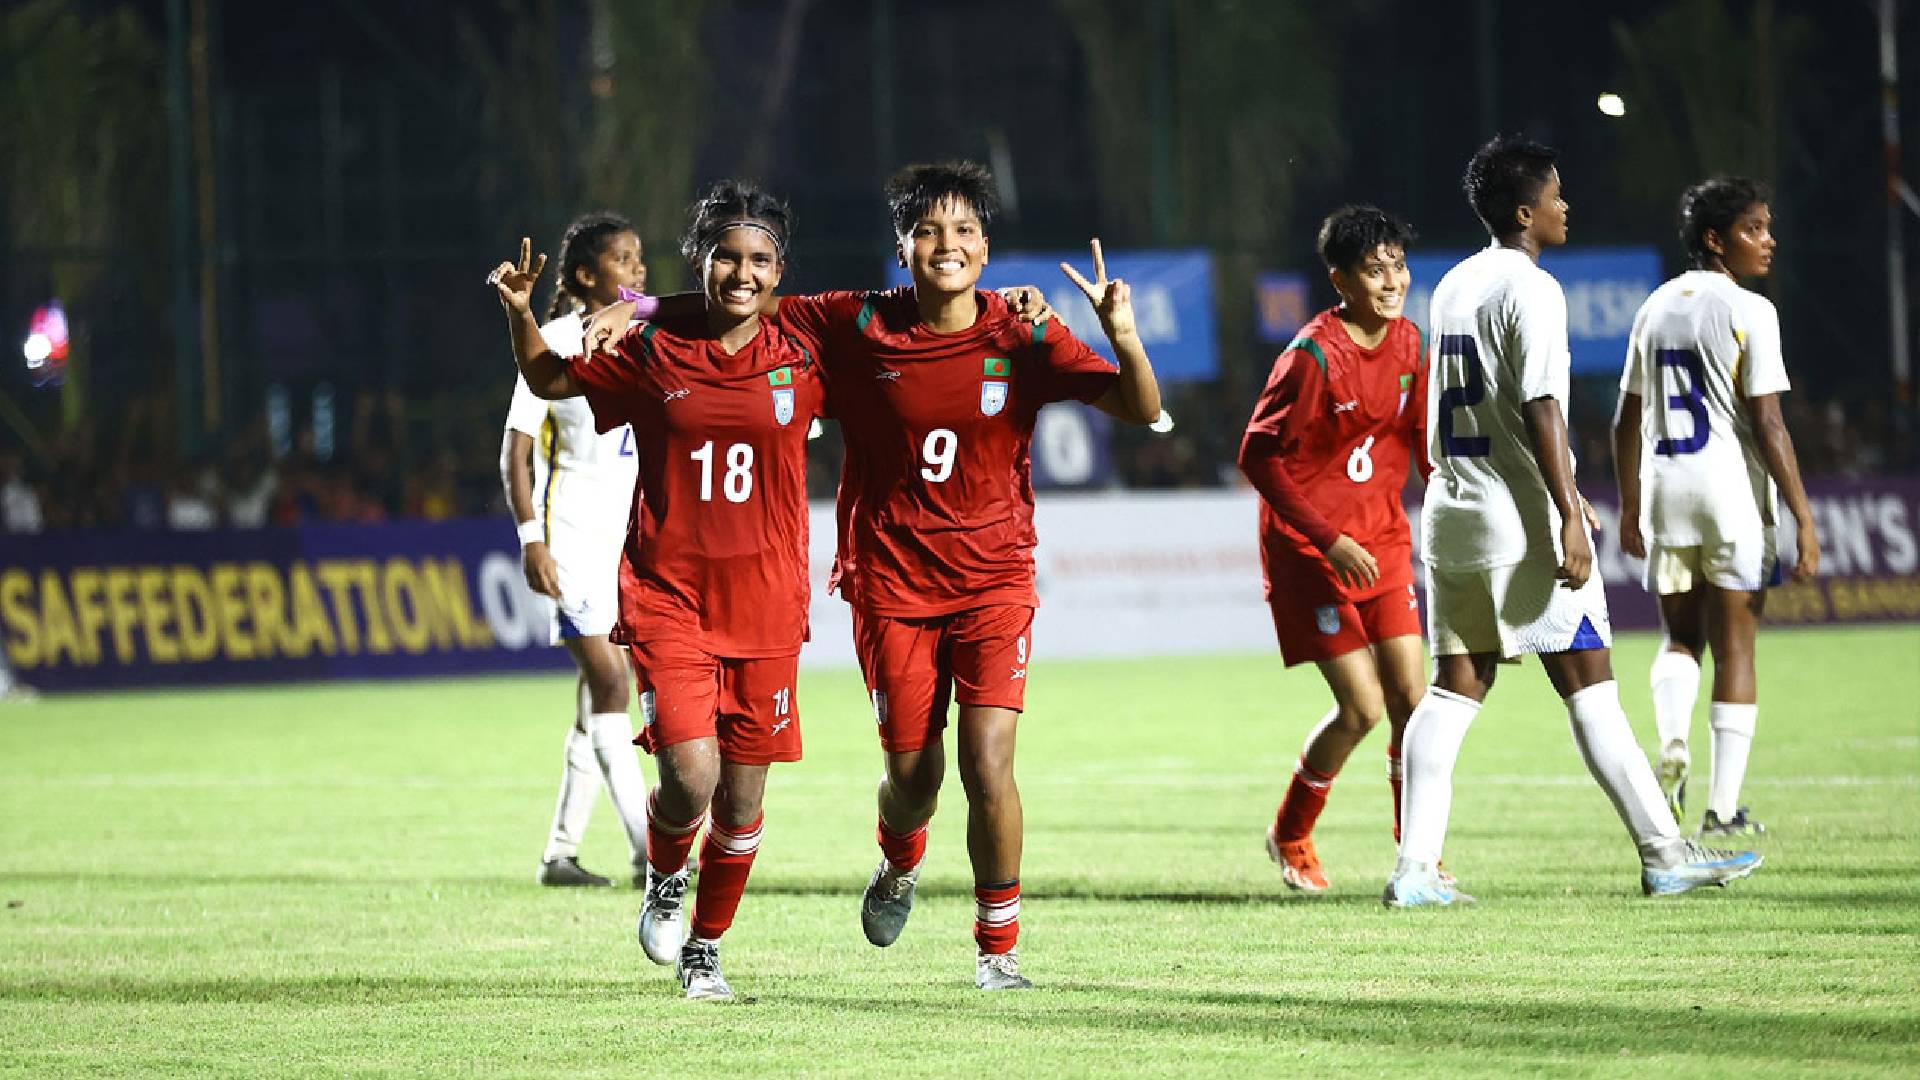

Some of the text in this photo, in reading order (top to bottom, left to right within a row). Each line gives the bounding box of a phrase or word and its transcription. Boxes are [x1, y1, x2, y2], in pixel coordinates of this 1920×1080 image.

[1438, 334, 1490, 457] 2
[1655, 349, 1711, 456] 3
[690, 440, 754, 503] 18
[920, 428, 958, 483] 9
[1346, 434, 1375, 483] 6
[1016, 636, 1026, 664] 9
[772, 686, 789, 717] 18
